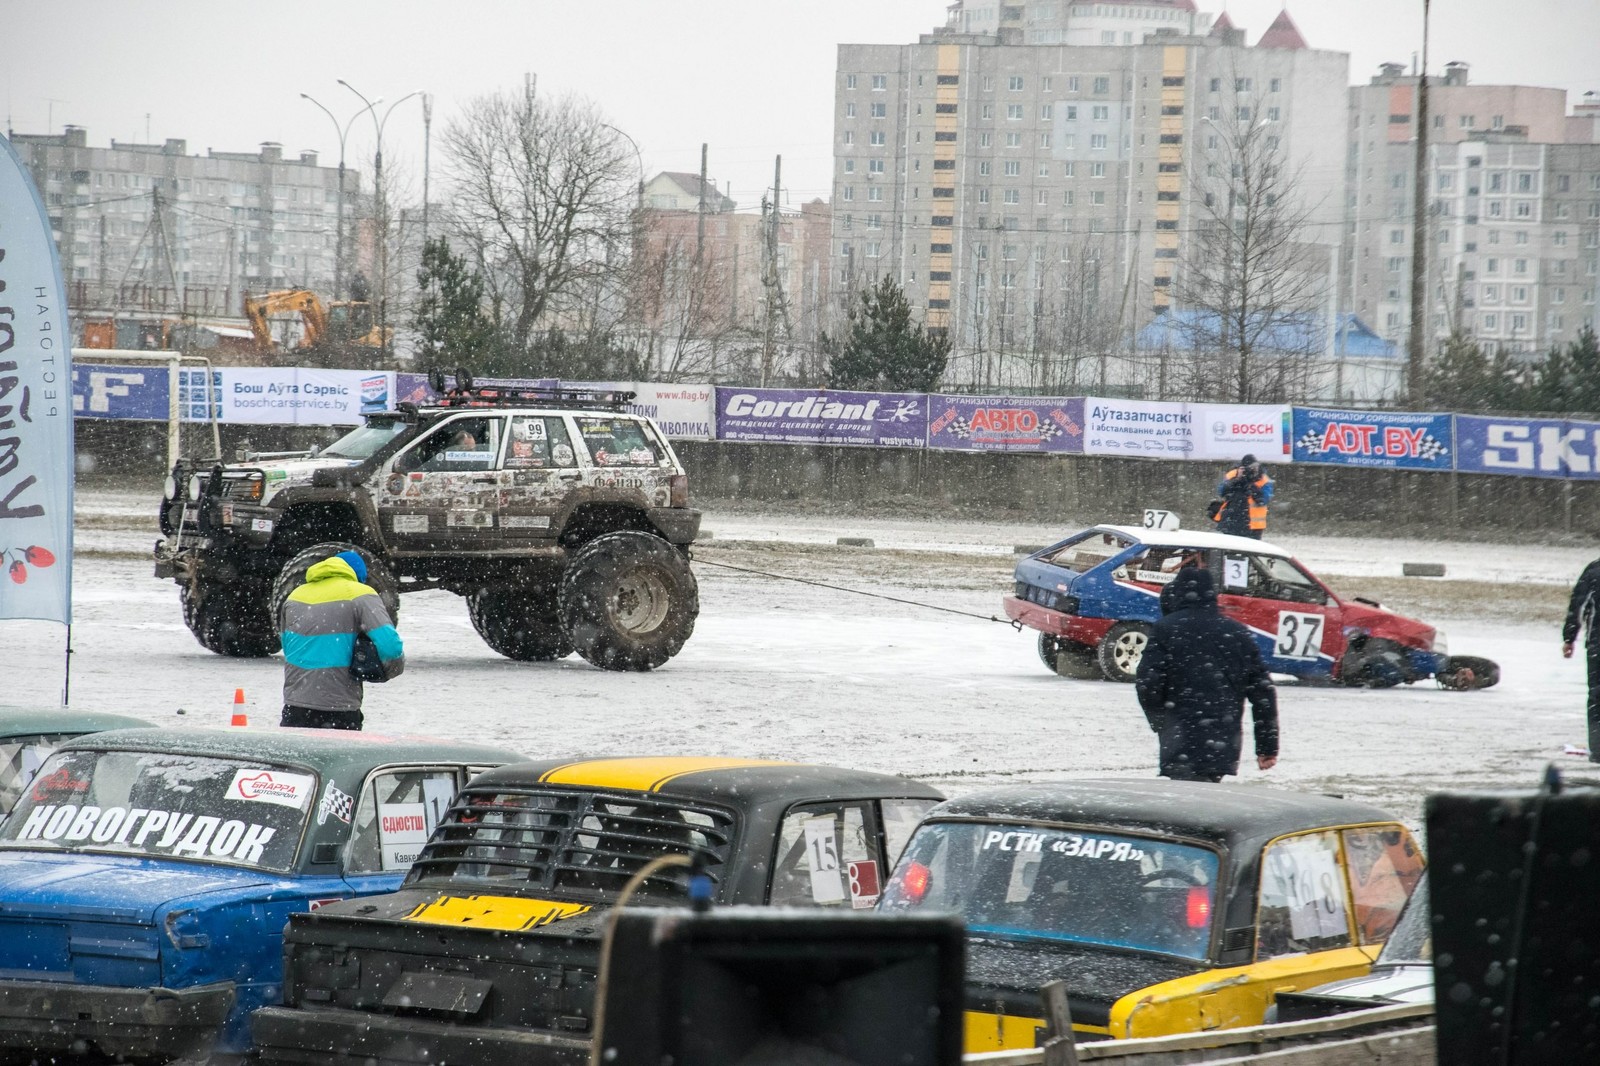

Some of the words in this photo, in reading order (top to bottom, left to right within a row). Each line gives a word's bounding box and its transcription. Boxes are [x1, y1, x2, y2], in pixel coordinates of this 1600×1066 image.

[234, 383, 263, 394] Бош
[268, 383, 299, 396] Аўта
[303, 384, 349, 397] Сэрвіс
[656, 390, 710, 401] www.flag.by
[234, 397, 348, 411] boschcarservice.by
[725, 393, 881, 421] Cordiant
[945, 396, 1001, 406] ОРГАНИЗАТОР
[969, 408, 1039, 432] АВТО
[1092, 406, 1192, 424] Аўтазапчасткі
[1309, 411, 1364, 421] ОРГАНИЗАТОР
[528, 424, 543, 435] 99
[1175, 428, 1192, 436] СТА
[1232, 424, 1274, 434] BOSCH
[880, 436, 925, 448] rustyre.by
[1321, 422, 1427, 458] ADT.BY
[1483, 424, 1600, 473] SK
[1144, 511, 1169, 528] 37
[1231, 564, 1242, 579] 3
[1278, 615, 1322, 656] 37
[251, 781, 296, 794] GRAPPA
[252, 789, 299, 800] MOTORSPORT
[382, 815, 424, 834] СДЮСТШ
[15, 804, 277, 863] НОВОГРУДОК
[812, 836, 837, 872] 15
[983, 831, 1047, 852] РСТК
[1052, 836, 1145, 862] «ЗАРЯ»
